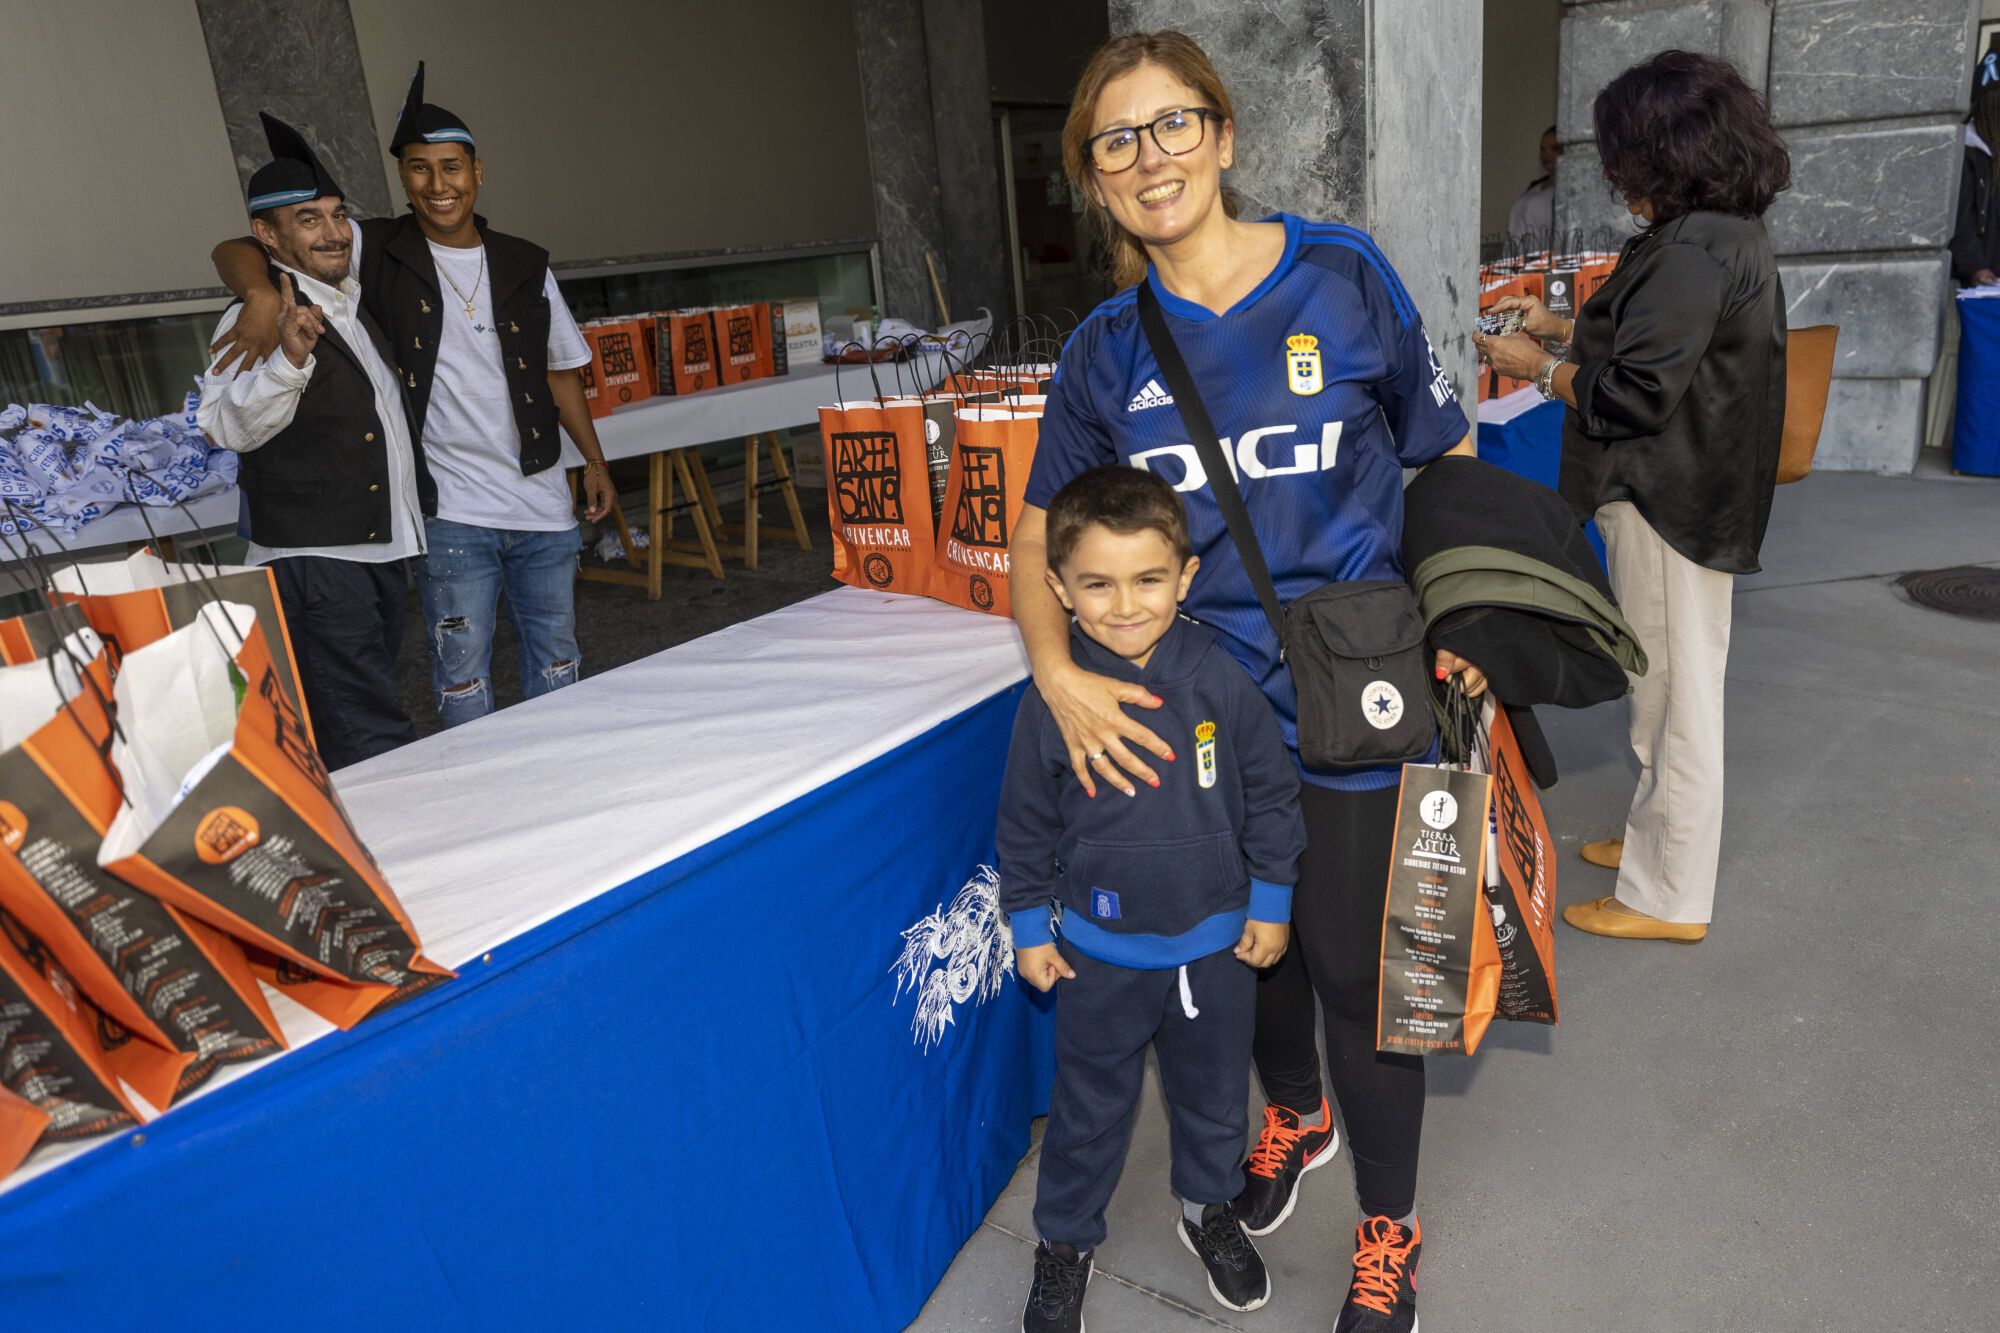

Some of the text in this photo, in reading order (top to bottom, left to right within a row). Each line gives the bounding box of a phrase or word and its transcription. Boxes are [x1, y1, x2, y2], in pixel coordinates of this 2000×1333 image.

[1128, 393, 1174, 412] adidas
[838, 438, 896, 474] ARTE
[1129, 421, 1343, 493] DIGI
[842, 527, 911, 547] CRIVENCAR
[1420, 829, 1456, 843] TIERRA
[1413, 838, 1461, 857] ASTUR
